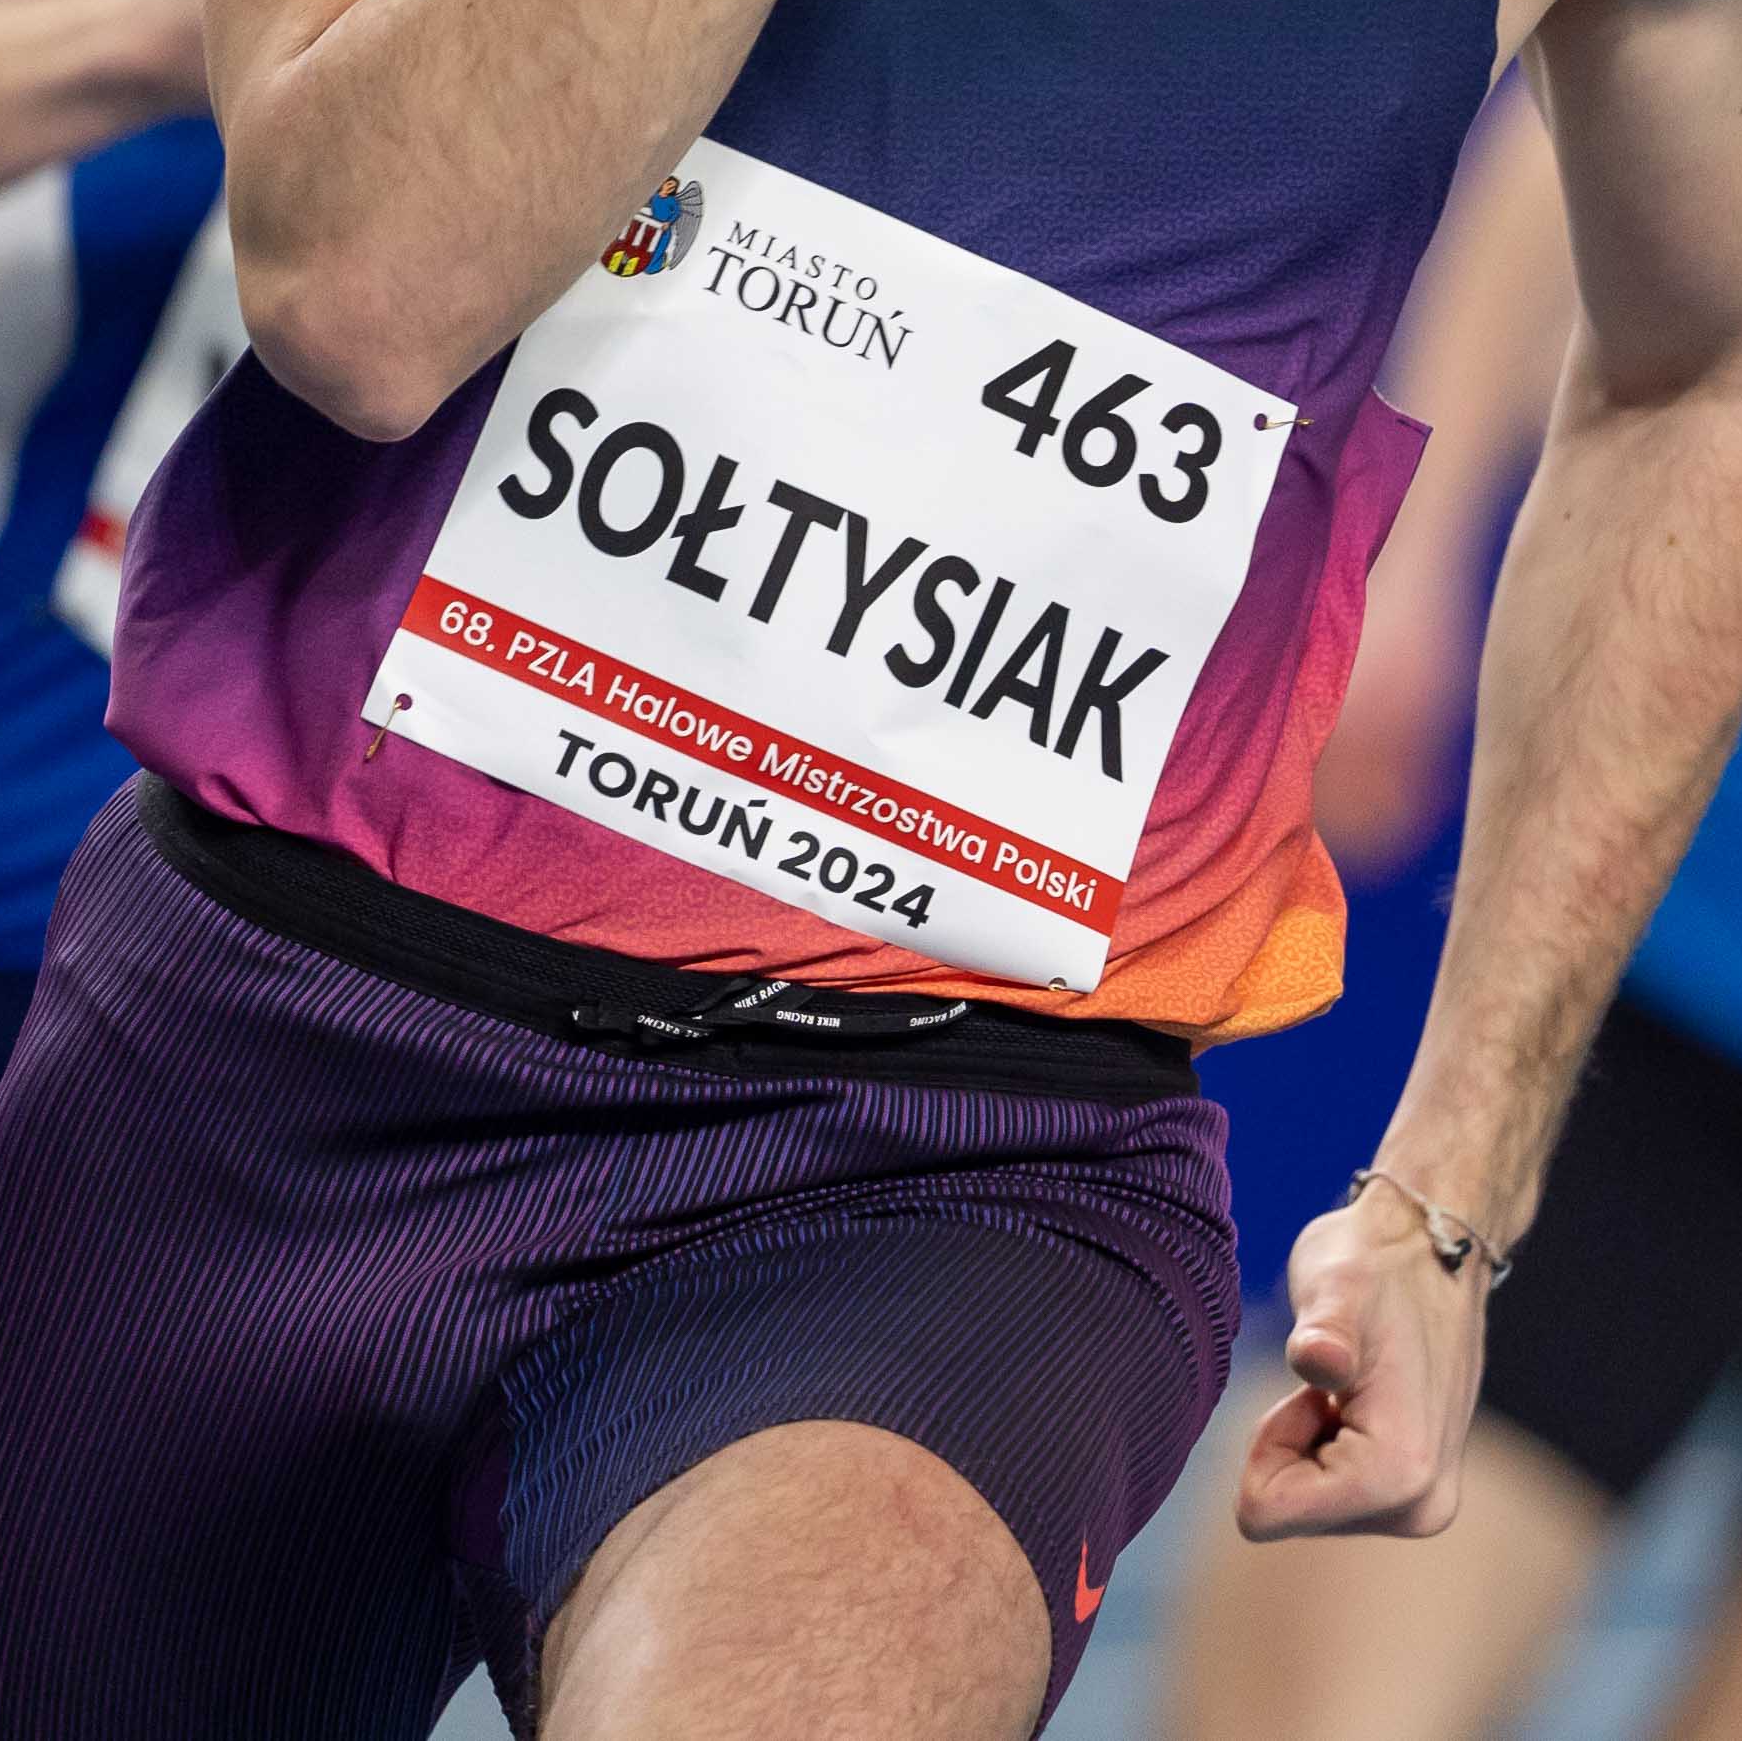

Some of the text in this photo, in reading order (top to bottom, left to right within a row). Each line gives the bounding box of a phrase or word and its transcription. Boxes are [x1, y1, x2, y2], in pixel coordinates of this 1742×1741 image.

[703, 246, 914, 370] TORUŃ
[726, 221, 878, 301] MIASTO
[981, 339, 1222, 524] 463
[497, 387, 1171, 783] SOŁTYSIAK
[439, 601, 1098, 912] 68. PZLA Halowe Mistrzostwa Polski
[555, 729, 936, 930] TORUŃ 2024
[776, 1010, 841, 1028] NIKE RACING
